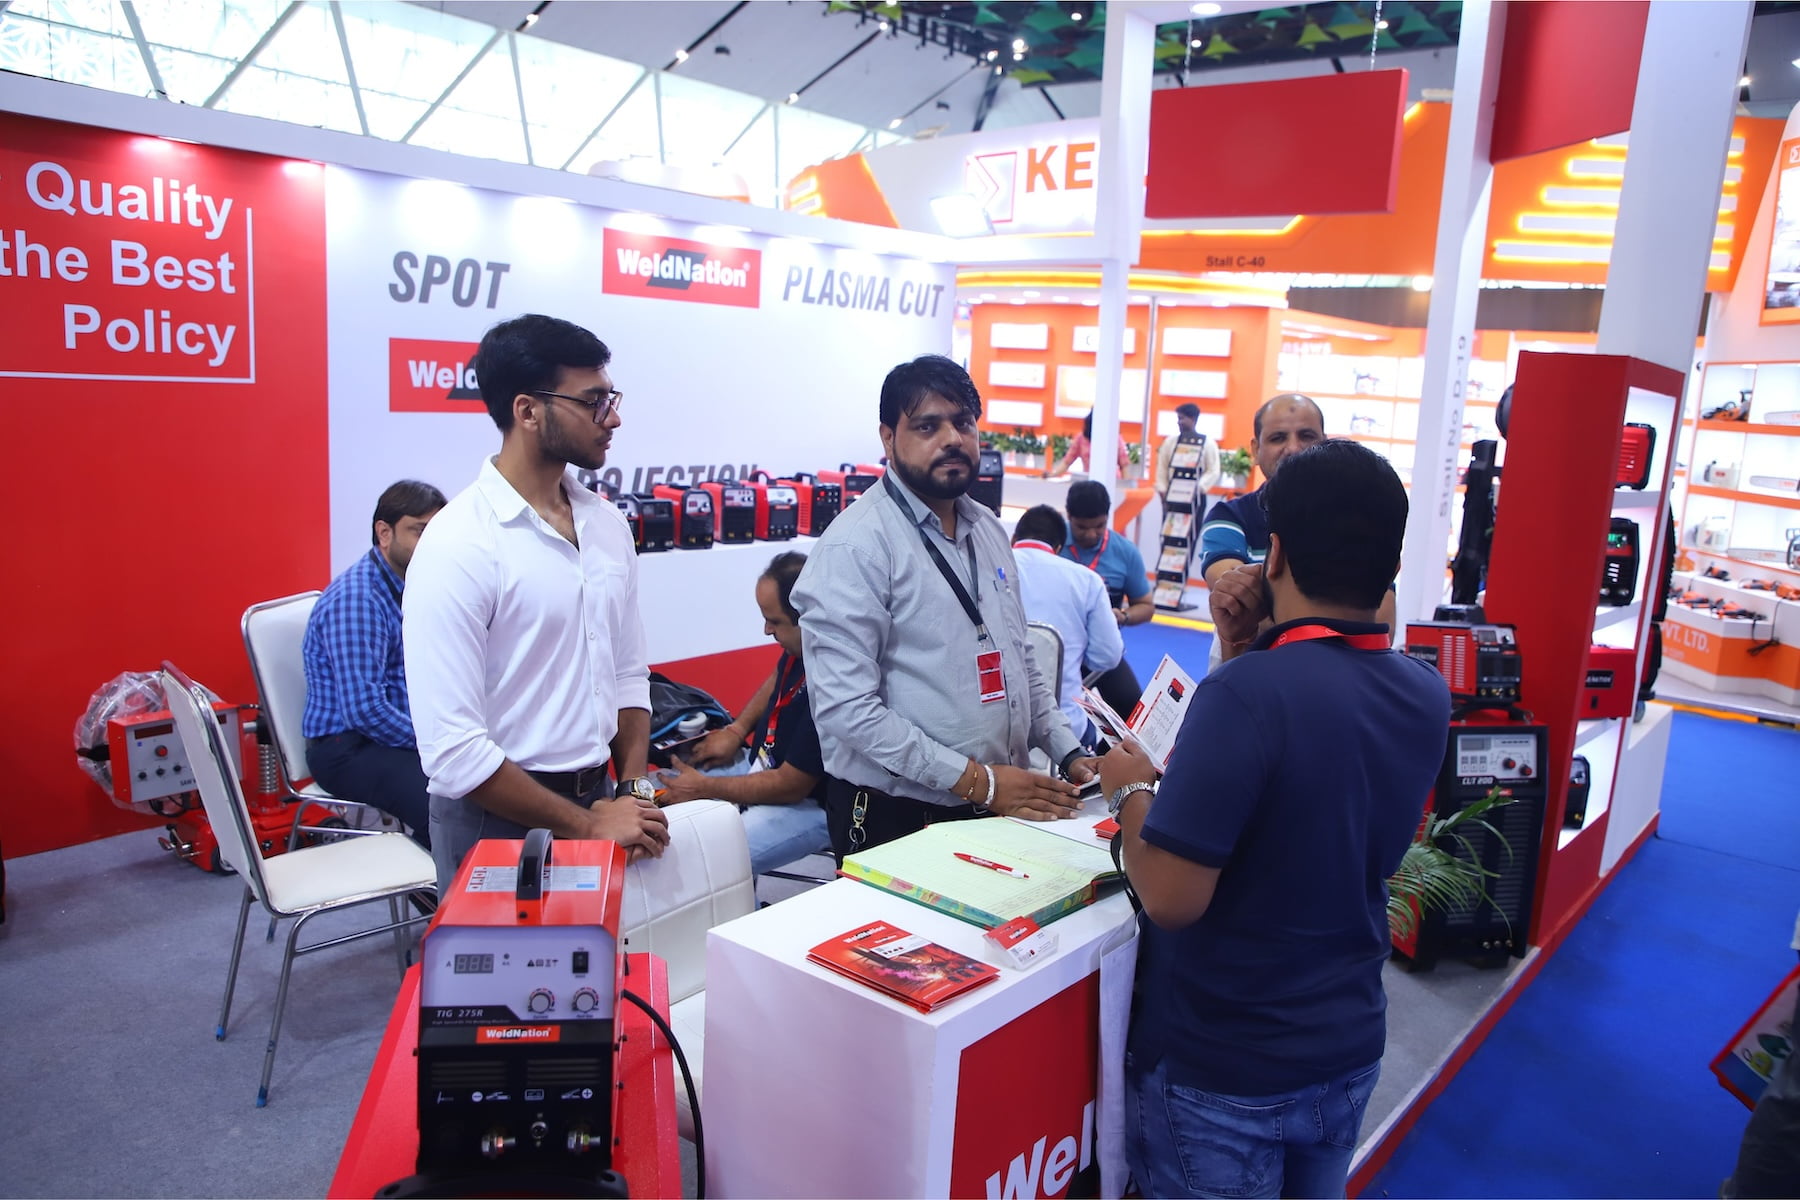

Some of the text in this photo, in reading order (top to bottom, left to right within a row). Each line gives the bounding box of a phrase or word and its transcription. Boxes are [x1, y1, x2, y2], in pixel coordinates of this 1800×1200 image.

[1026, 142, 1095, 193] KE
[25, 161, 233, 240] Quality
[0, 229, 236, 294] the Best
[389, 250, 510, 309] SPOT
[1206, 255, 1266, 267] Stall C-40
[783, 265, 945, 318] PLASMA CUT
[63, 303, 236, 368] Policy
[1683, 628, 1710, 654] LTD.
[436, 1008, 484, 1018] TIG 275R
[985, 1099, 1096, 1200] Wel
